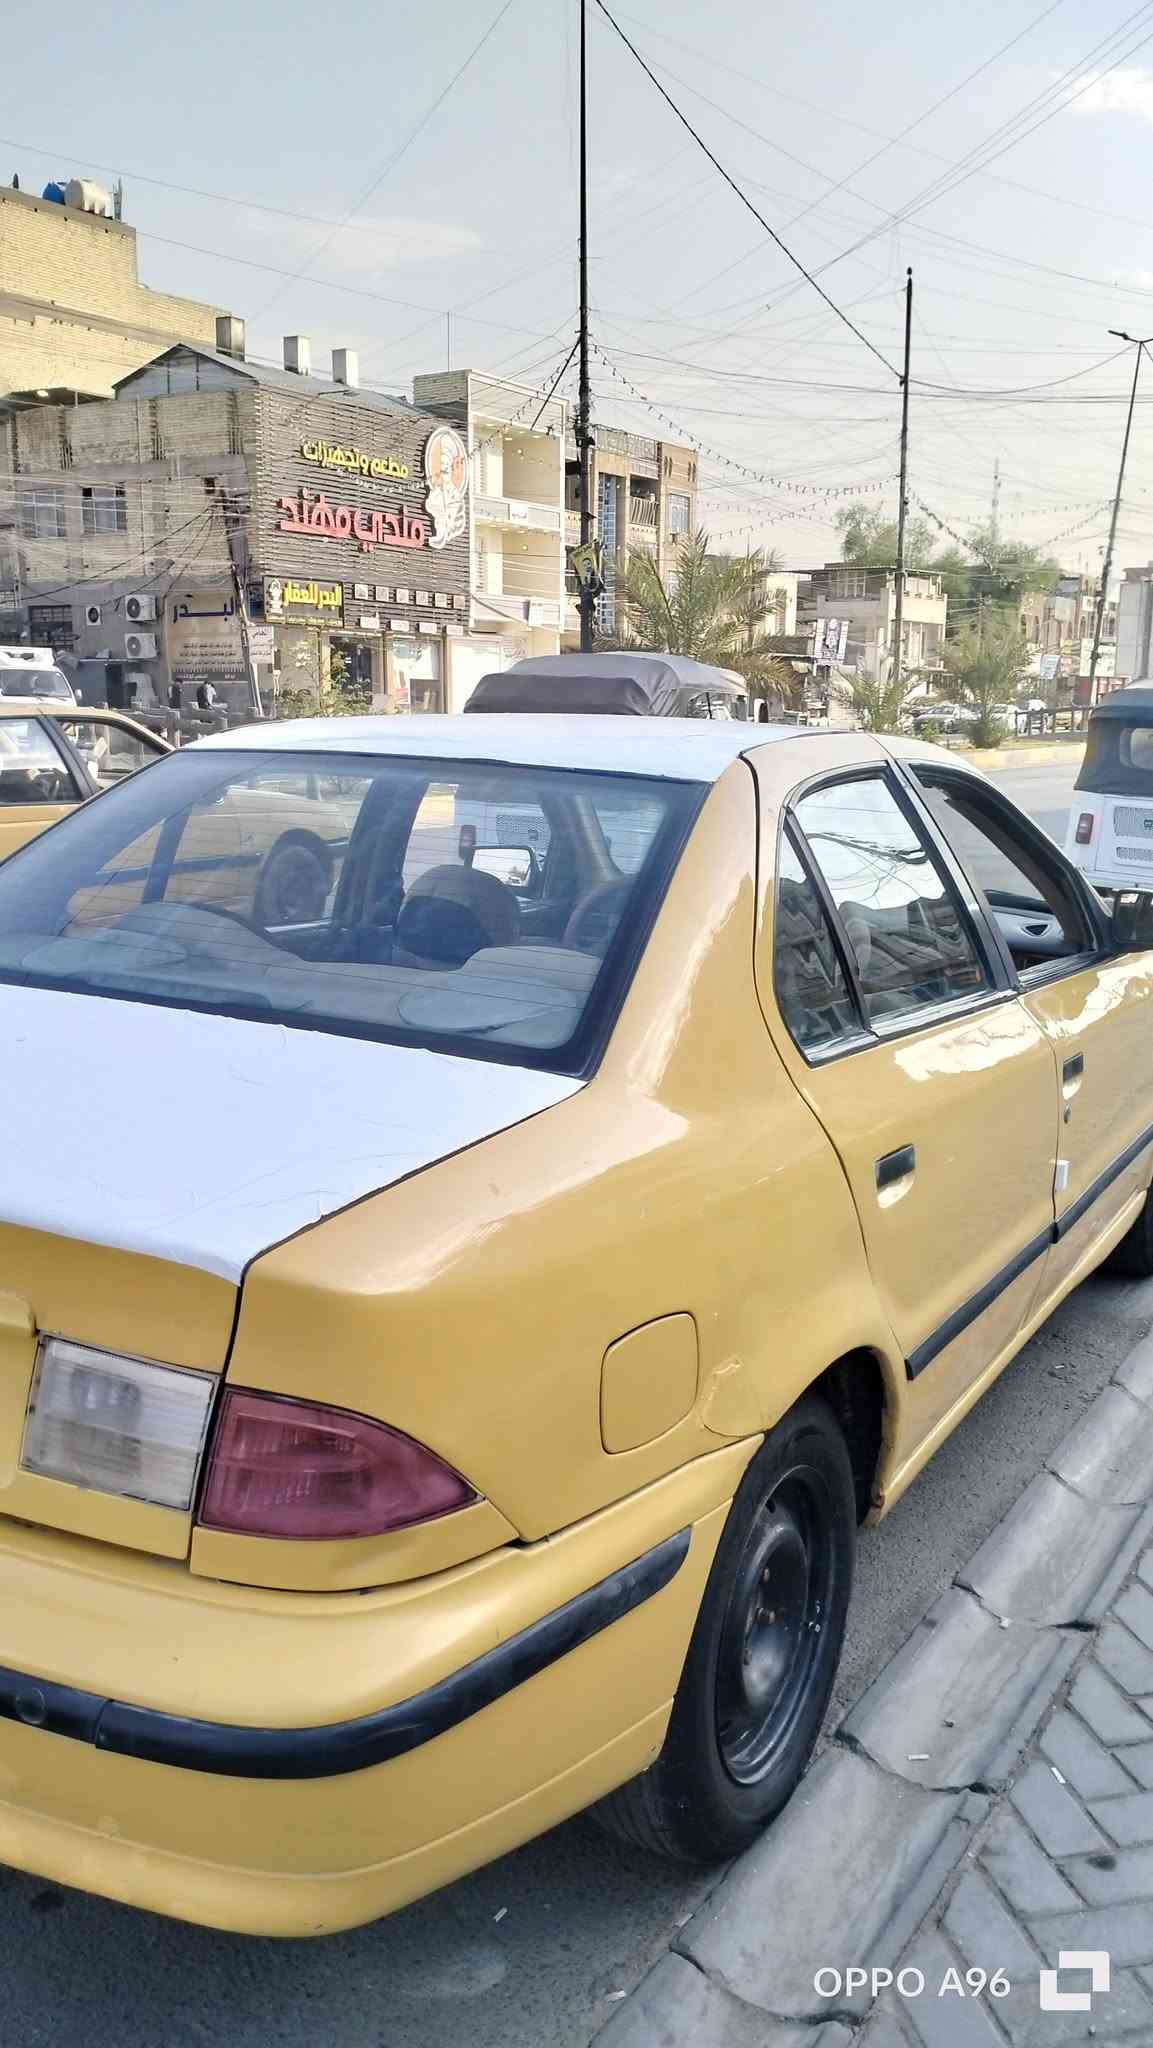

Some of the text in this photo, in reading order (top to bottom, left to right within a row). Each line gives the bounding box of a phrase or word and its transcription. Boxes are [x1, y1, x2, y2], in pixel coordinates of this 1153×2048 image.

[303, 440, 409, 479] مطعم وتجهيزات
[279, 487, 426, 553] مندي مهند
[282, 580, 343, 611] البدر للعقار
